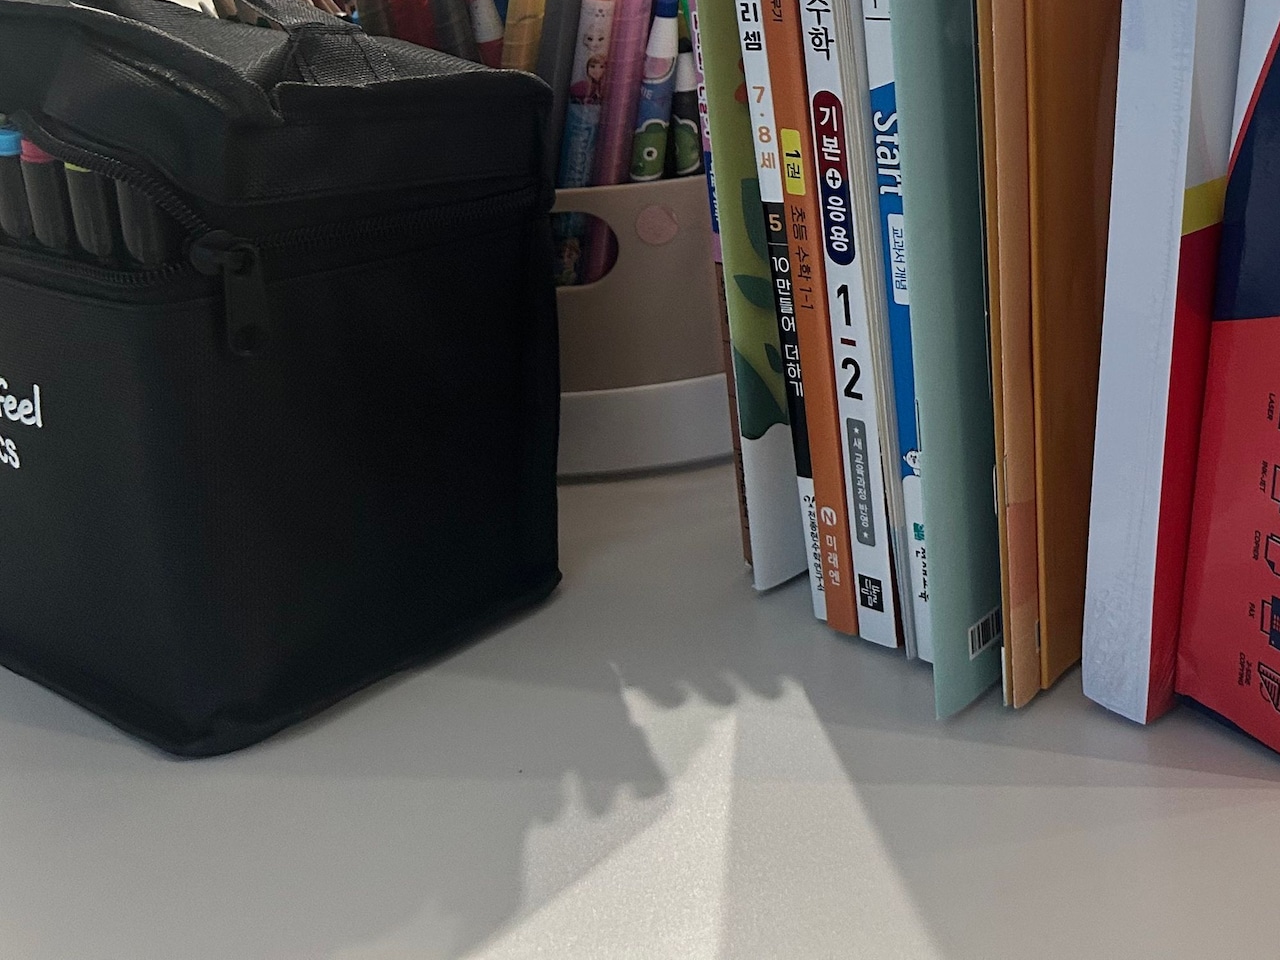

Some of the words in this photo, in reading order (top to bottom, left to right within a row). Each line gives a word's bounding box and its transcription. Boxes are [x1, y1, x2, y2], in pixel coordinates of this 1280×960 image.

[785, 150, 801, 180] 1권
[873, 110, 902, 196] Start
[790, 204, 808, 241] 초등
[794, 246, 813, 282] 수학
[776, 278, 796, 332] 만들어
[798, 286, 814, 311] 1-1
[836, 284, 863, 400] 1-2
